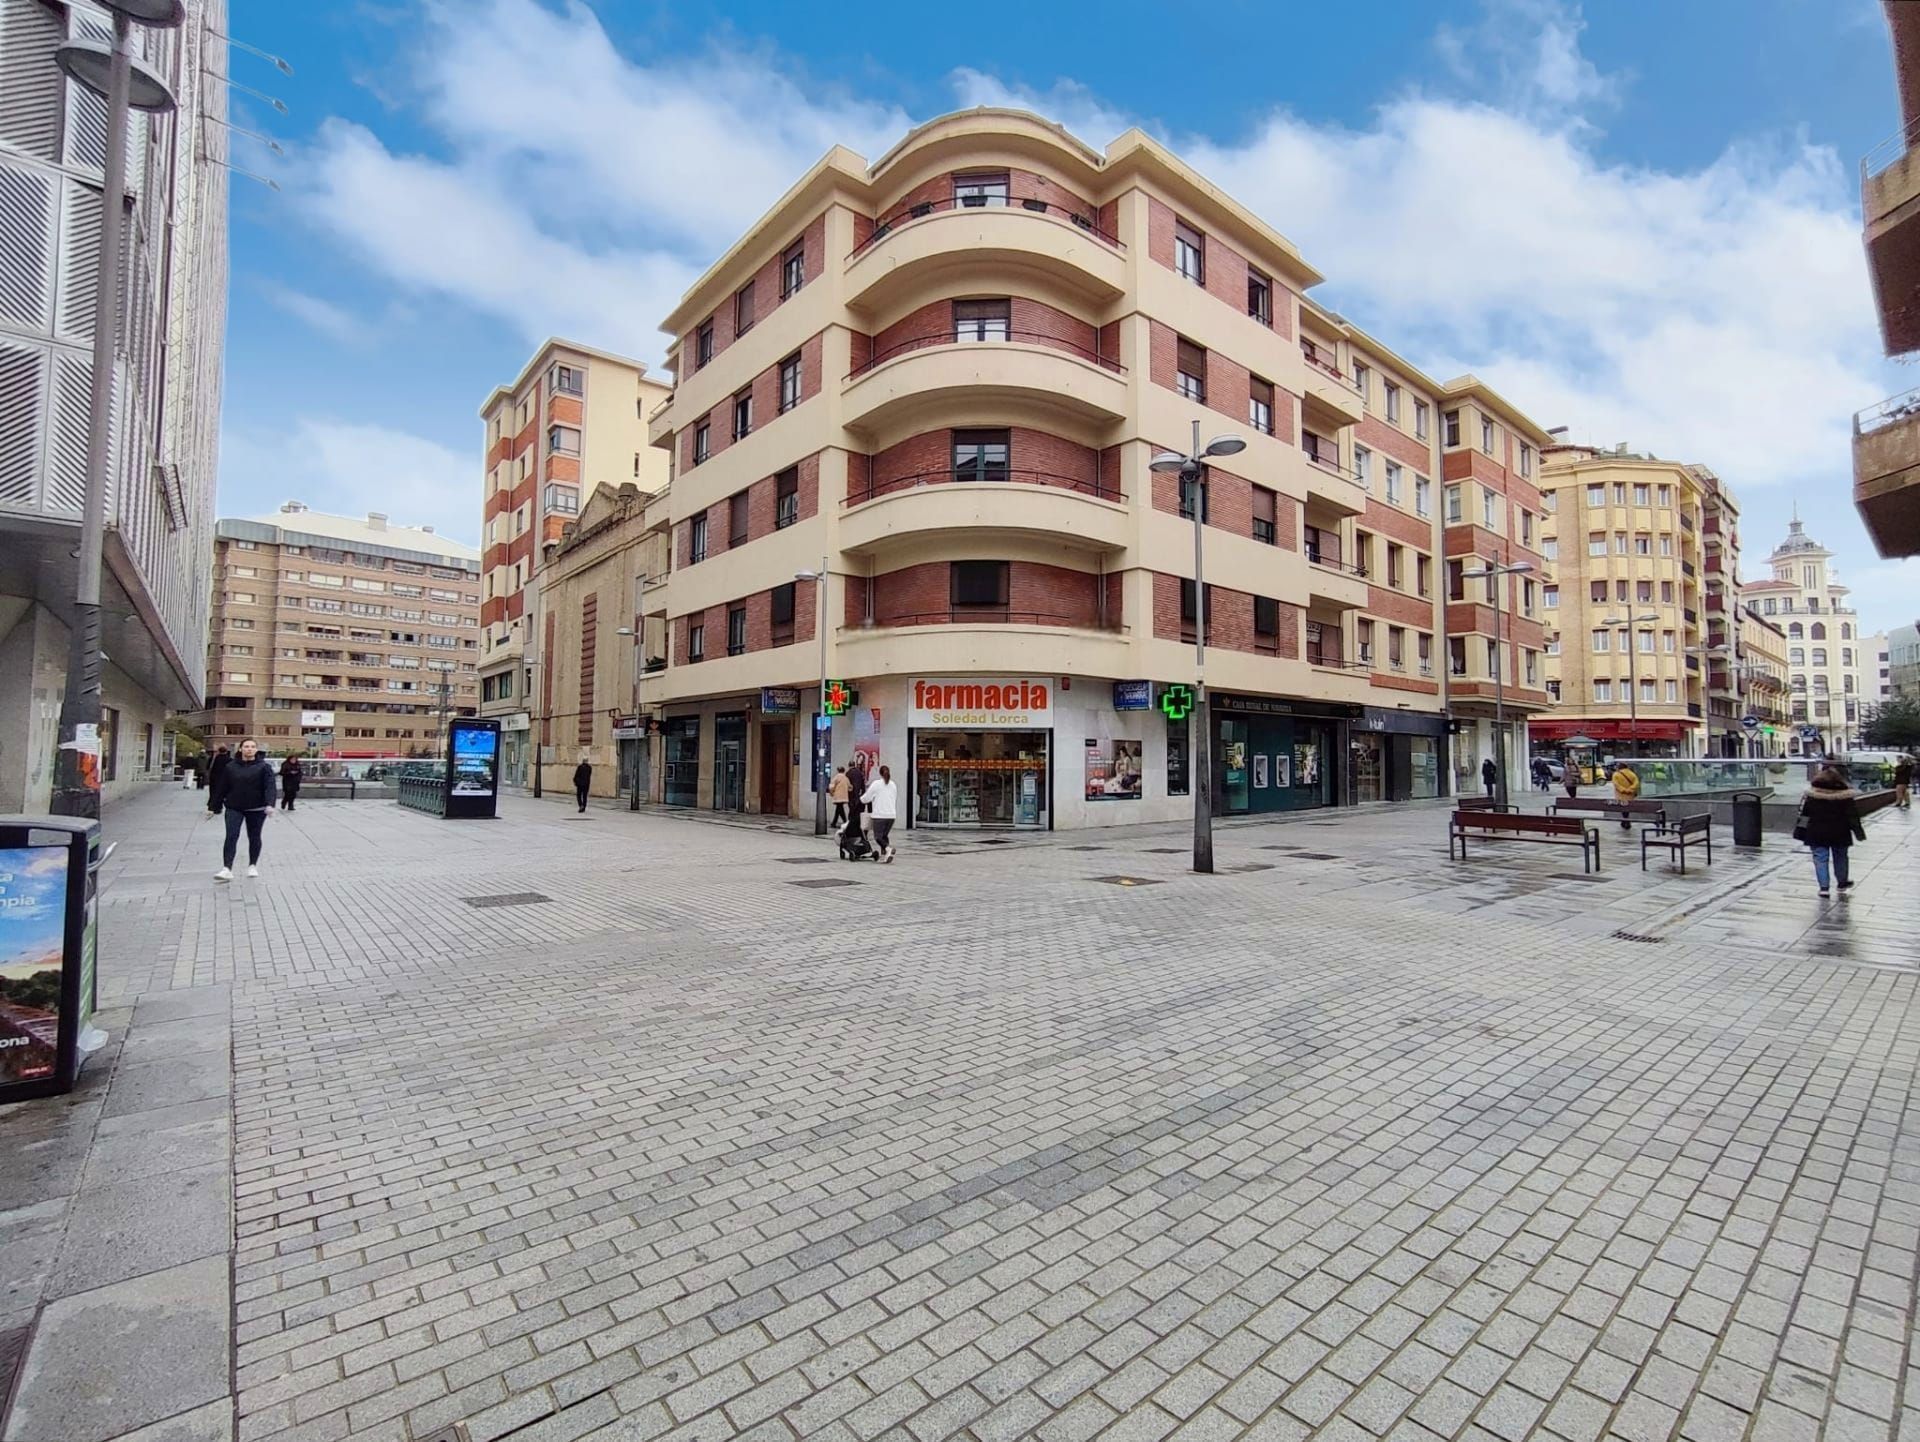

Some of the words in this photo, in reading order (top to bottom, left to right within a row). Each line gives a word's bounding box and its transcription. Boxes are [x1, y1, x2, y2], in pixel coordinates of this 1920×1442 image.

[914, 680, 1047, 710] farmacia
[932, 713, 986, 724] Soledad
[992, 713, 1028, 724] Lorca
